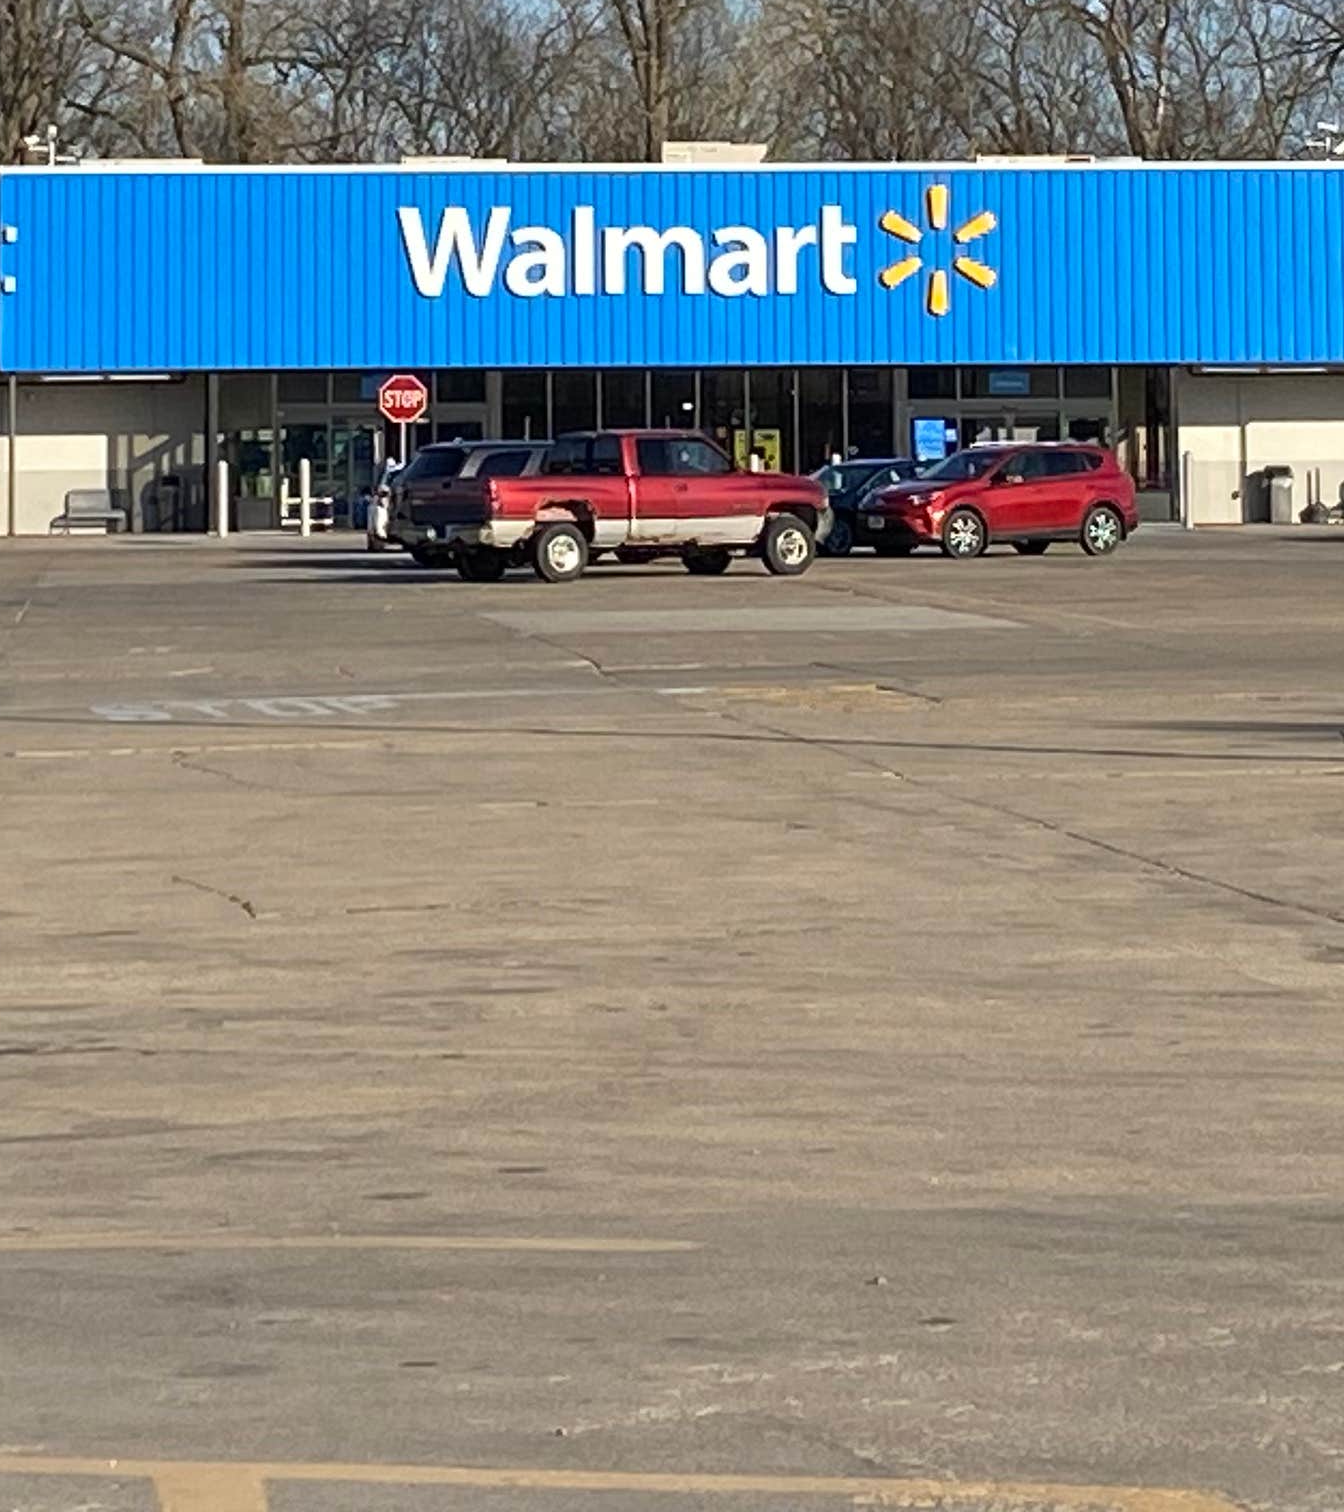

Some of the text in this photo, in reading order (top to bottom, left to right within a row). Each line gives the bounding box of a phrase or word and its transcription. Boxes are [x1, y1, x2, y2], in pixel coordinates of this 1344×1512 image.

[398, 205, 858, 298] Walmart
[383, 389, 423, 409] STOP
[90, 696, 398, 722] STOP
